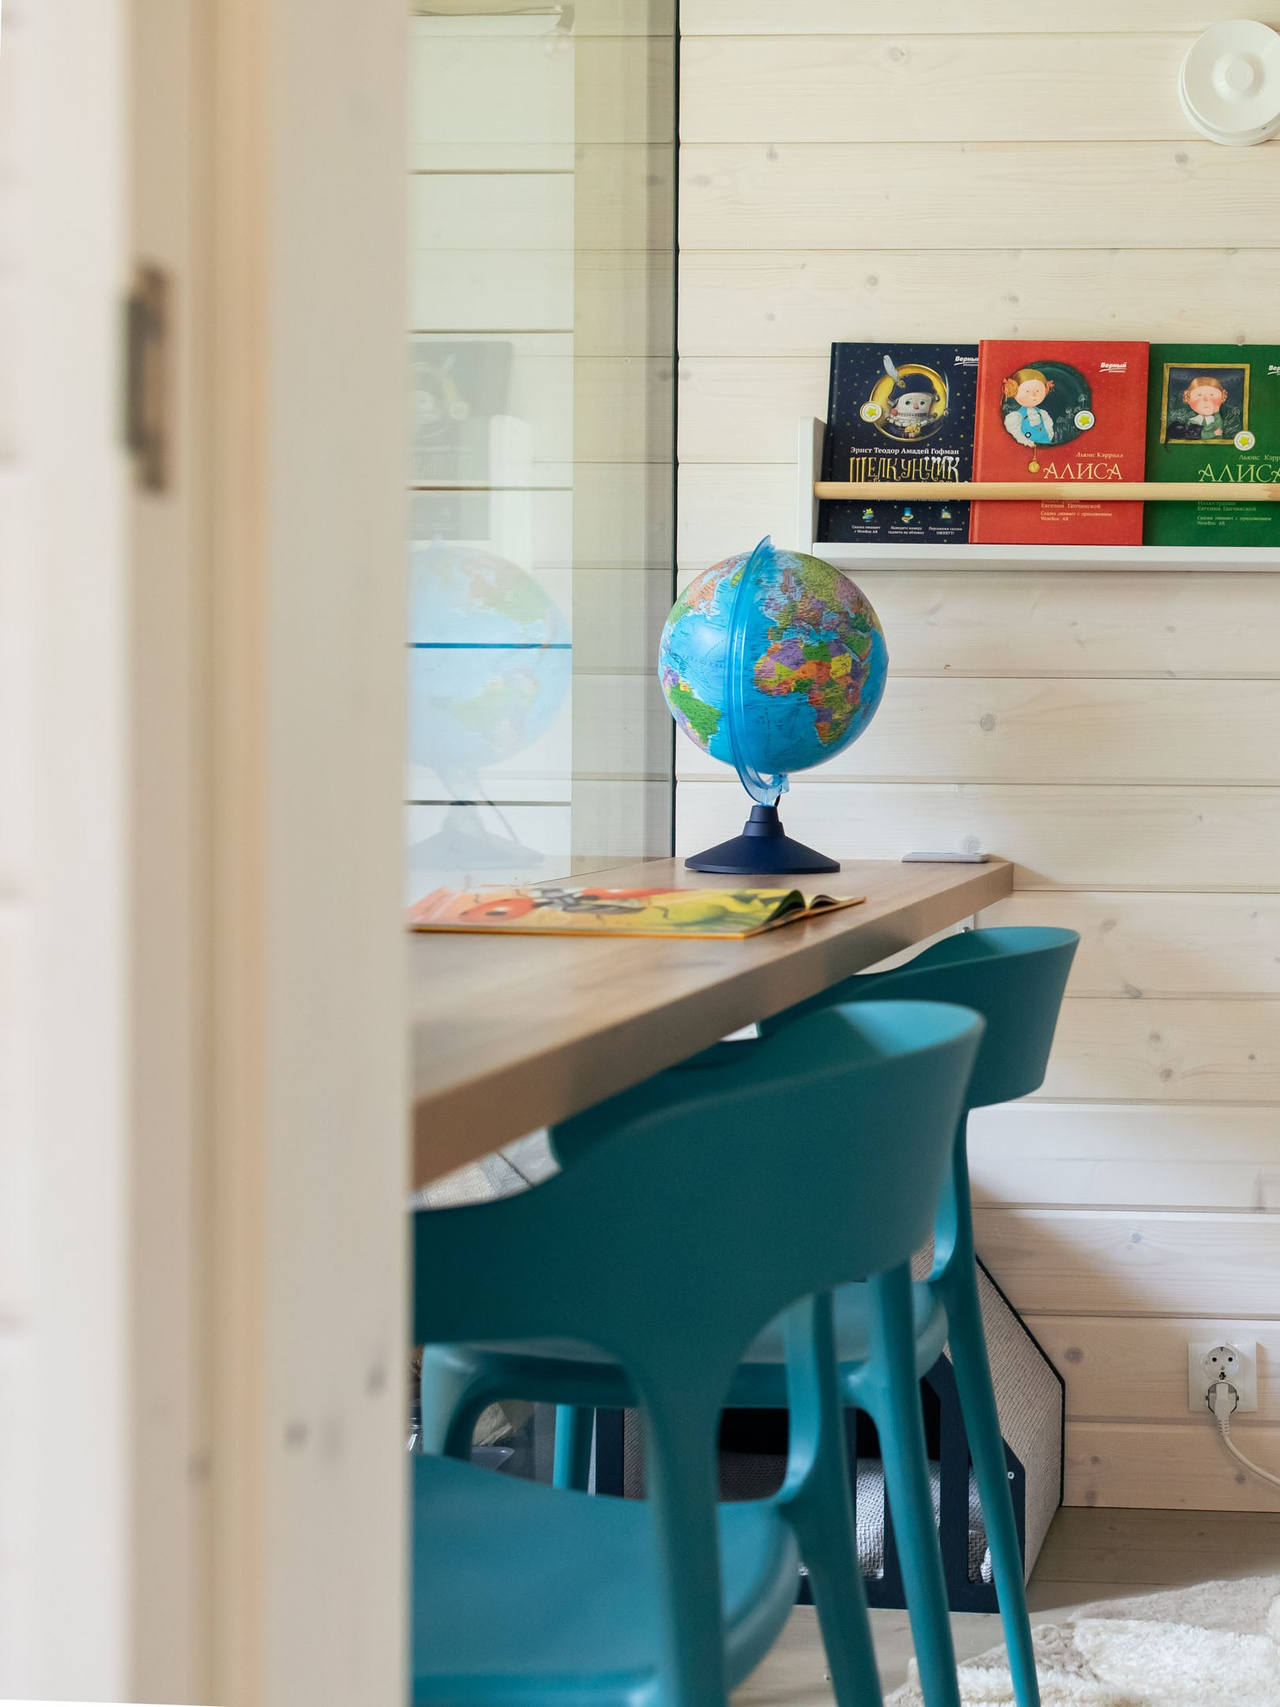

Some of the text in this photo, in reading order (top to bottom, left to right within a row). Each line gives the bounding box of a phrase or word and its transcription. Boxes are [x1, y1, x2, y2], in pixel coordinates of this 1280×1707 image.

[850, 446, 960, 456] Эрнст Теодор Амадей Гофман
[1097, 452, 1124, 460] Кэрролл
[1042, 462, 1123, 480] АЛИСА
